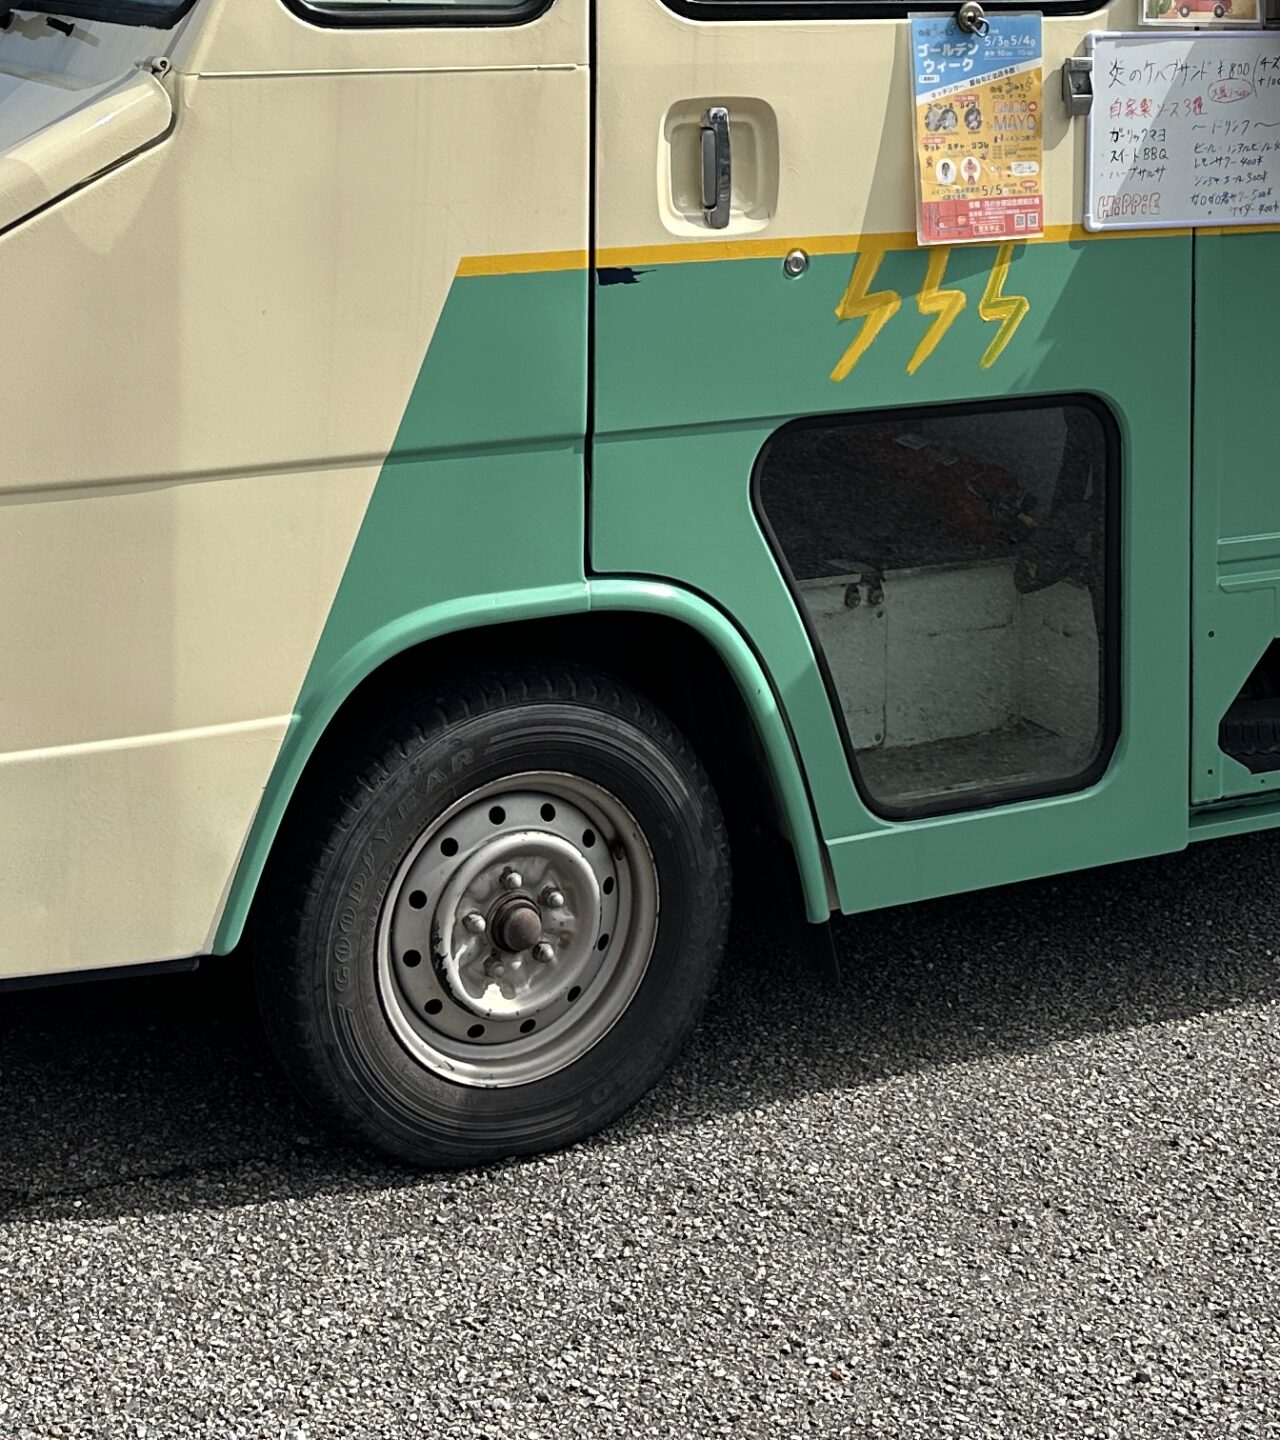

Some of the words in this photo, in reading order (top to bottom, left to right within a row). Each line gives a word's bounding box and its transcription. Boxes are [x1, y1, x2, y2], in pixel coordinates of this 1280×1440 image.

[917, 42, 979, 58] ゴールデン
[923, 58, 974, 74] ウィーク
